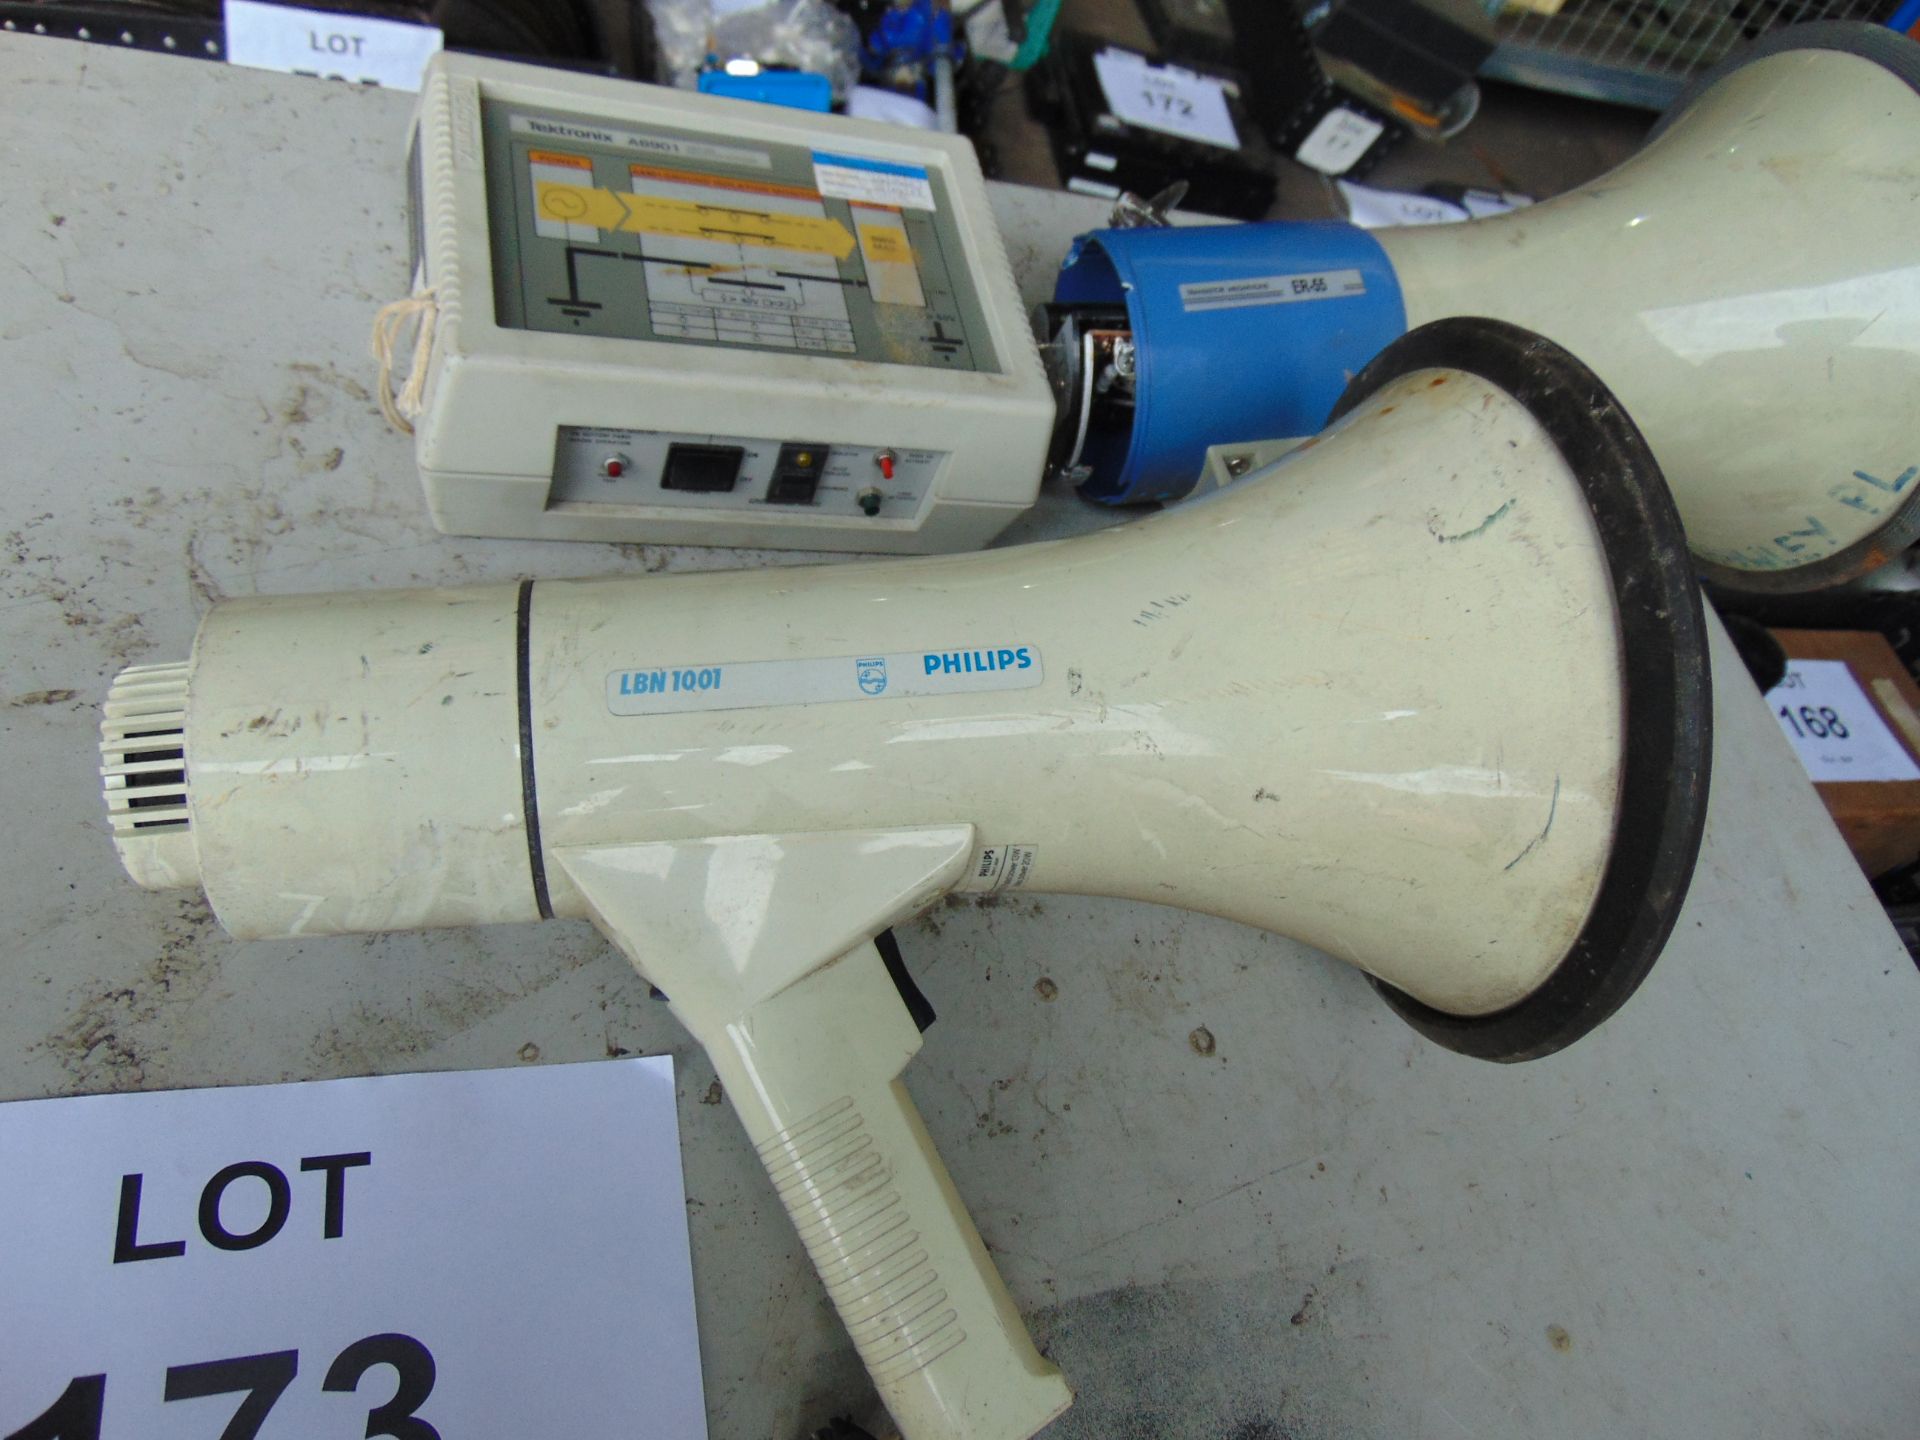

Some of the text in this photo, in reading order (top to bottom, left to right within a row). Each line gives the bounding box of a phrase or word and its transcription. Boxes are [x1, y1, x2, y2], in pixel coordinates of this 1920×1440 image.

[310, 31, 367, 57] LOT
[1142, 90, 1198, 119] 172
[527, 119, 614, 143] Tektronix
[923, 647, 1032, 676] PHILIPS
[619, 667, 722, 696] LBN 1001
[1780, 705, 1849, 740] 168
[978, 849, 995, 877] PHILIPS
[112, 1151, 372, 1264] LOT
